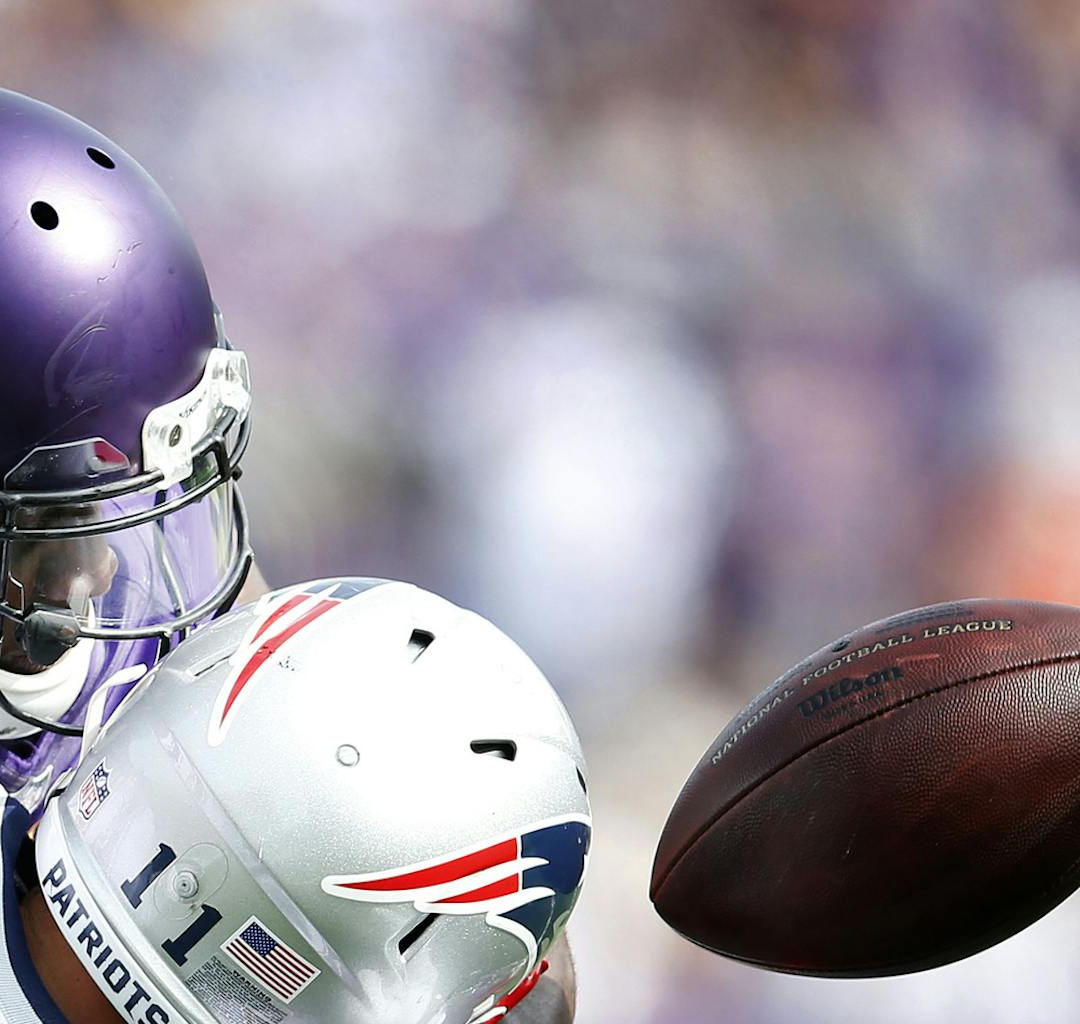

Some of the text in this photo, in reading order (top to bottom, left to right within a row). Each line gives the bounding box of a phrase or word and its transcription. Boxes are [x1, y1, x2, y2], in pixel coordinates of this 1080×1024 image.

[711, 688, 795, 766] NATIONAL
[802, 634, 914, 687] FOOTBALL
[923, 618, 1015, 639] LEAGUE
[796, 666, 905, 718] Wilson
